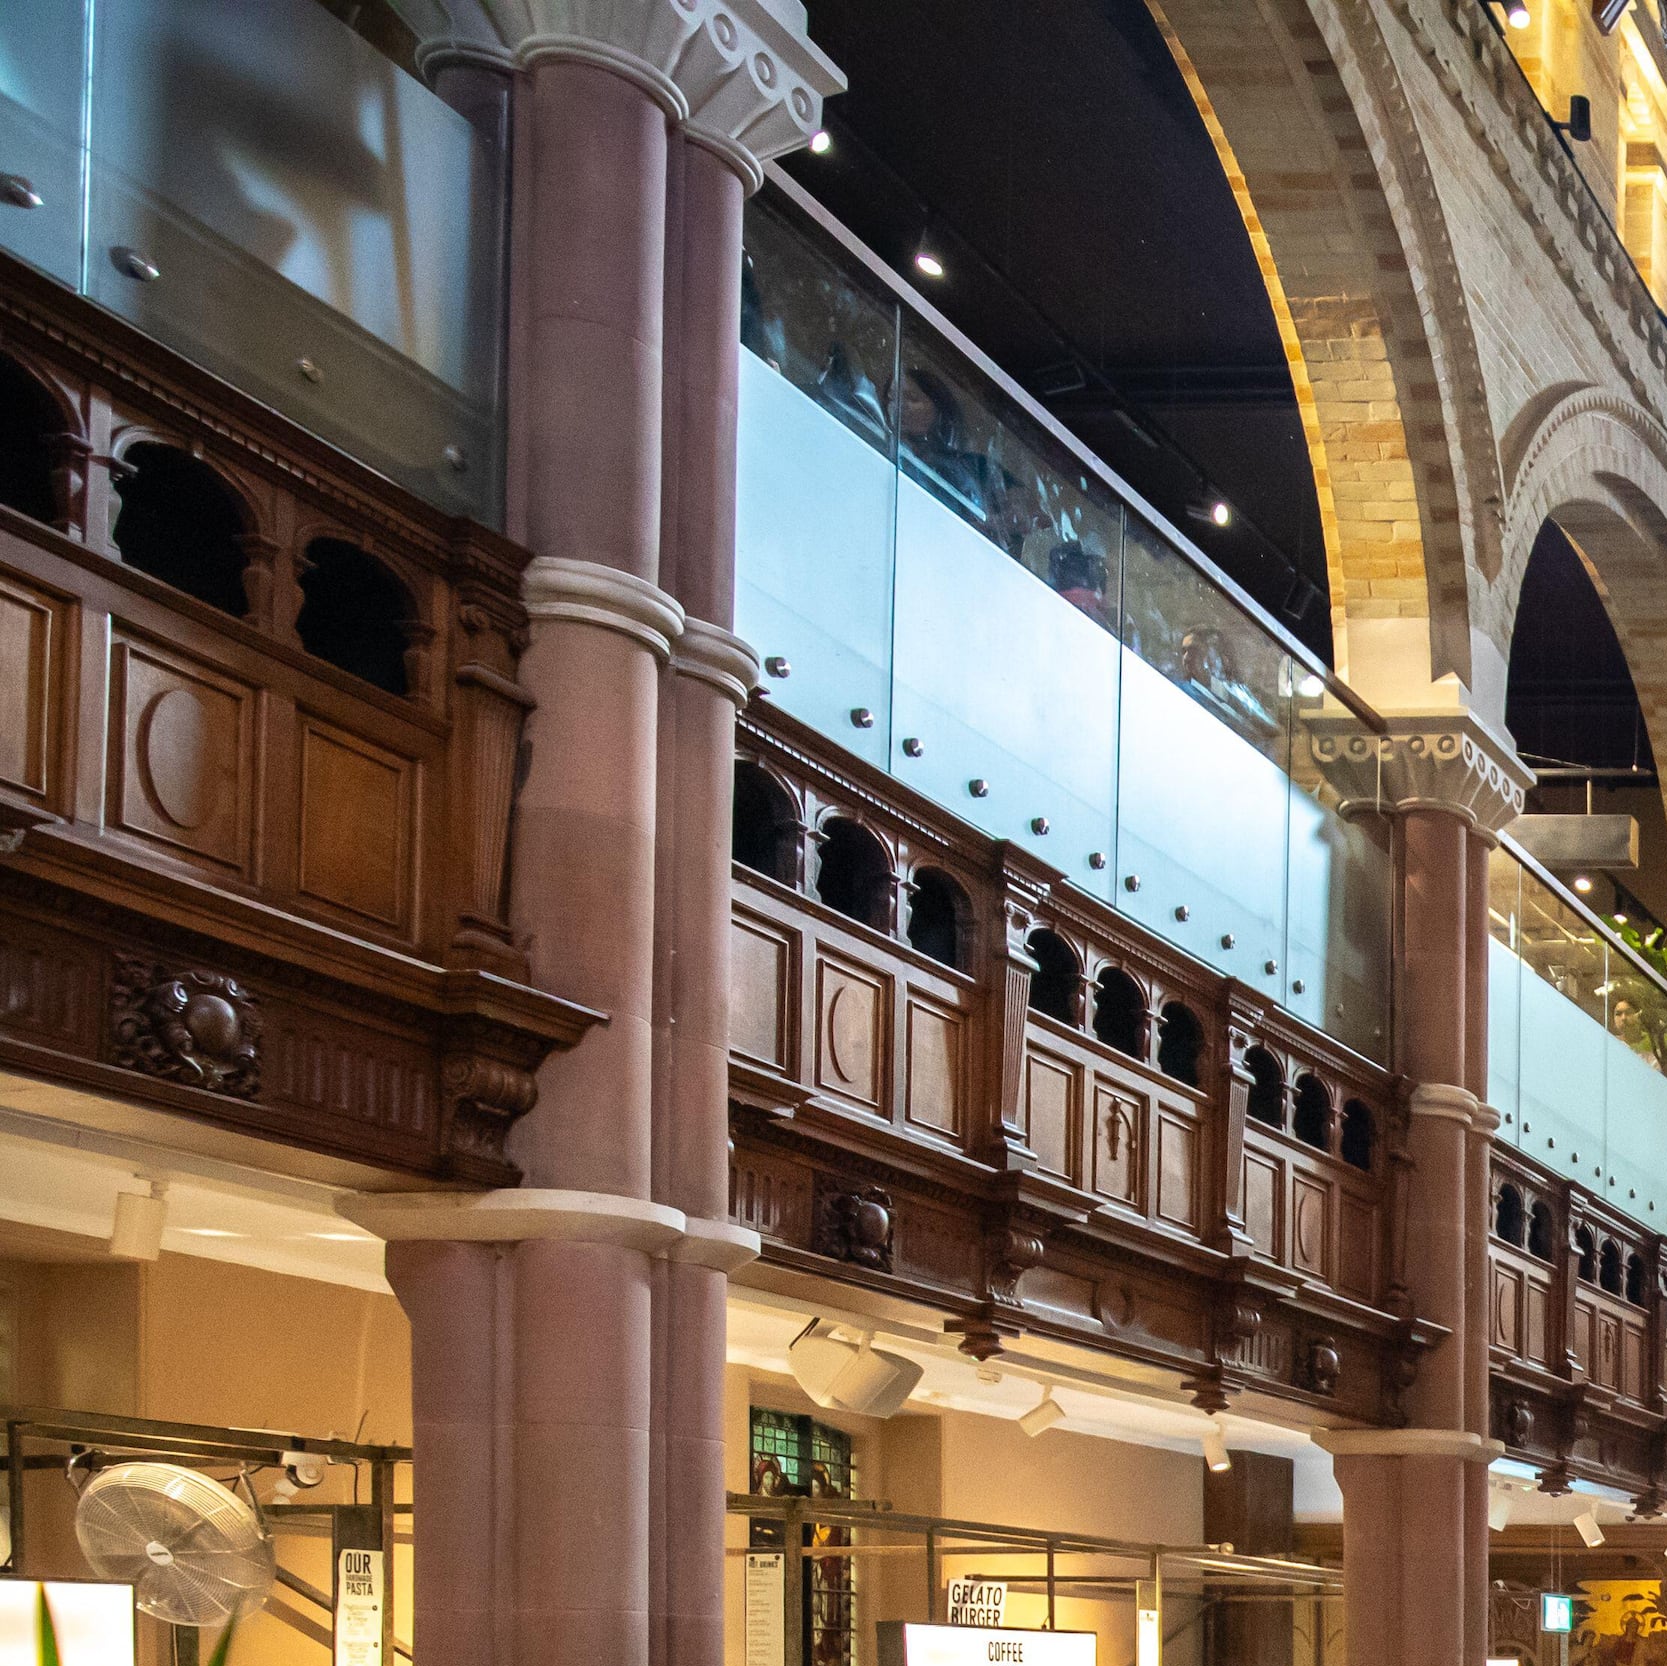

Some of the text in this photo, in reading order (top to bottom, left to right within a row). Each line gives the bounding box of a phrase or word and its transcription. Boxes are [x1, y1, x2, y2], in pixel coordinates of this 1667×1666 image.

[345, 1552, 371, 1574] OUR
[346, 1582, 373, 1596] PASTA
[952, 1584, 1002, 1606] GELATO
[951, 1606, 1000, 1627] BURGER
[988, 1641, 1023, 1662] COFFEE
